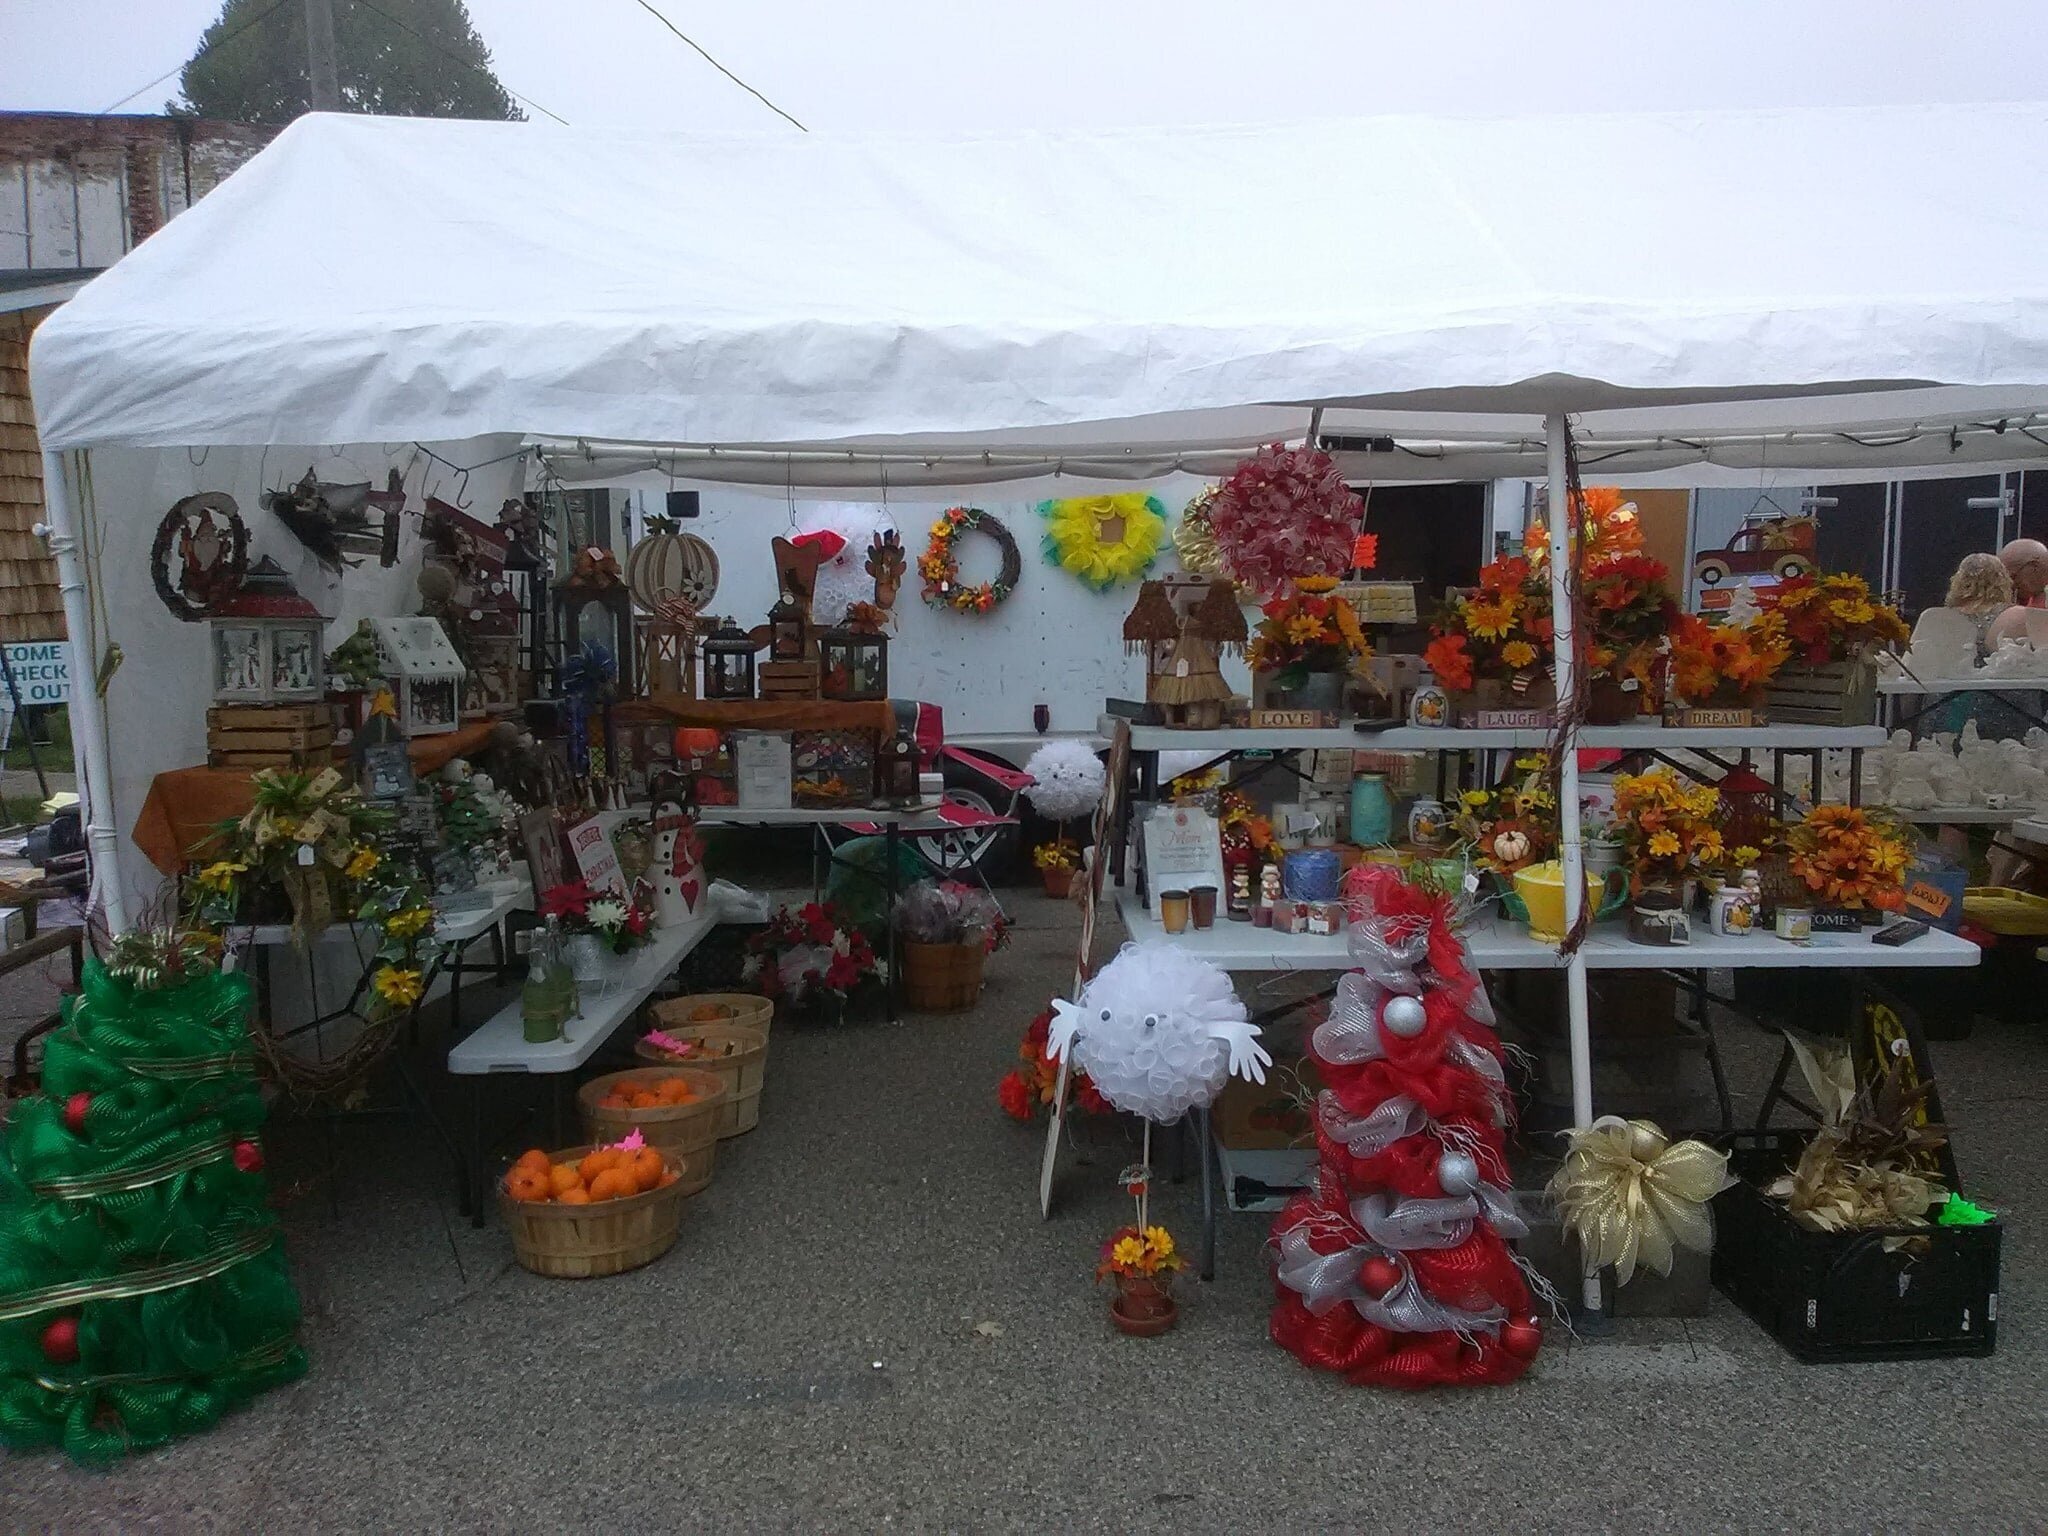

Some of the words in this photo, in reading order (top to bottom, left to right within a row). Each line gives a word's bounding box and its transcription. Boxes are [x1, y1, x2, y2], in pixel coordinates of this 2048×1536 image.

[4, 645, 62, 662] COME
[1261, 713, 1311, 726] LOVE
[1693, 711, 1742, 725] DREAM
